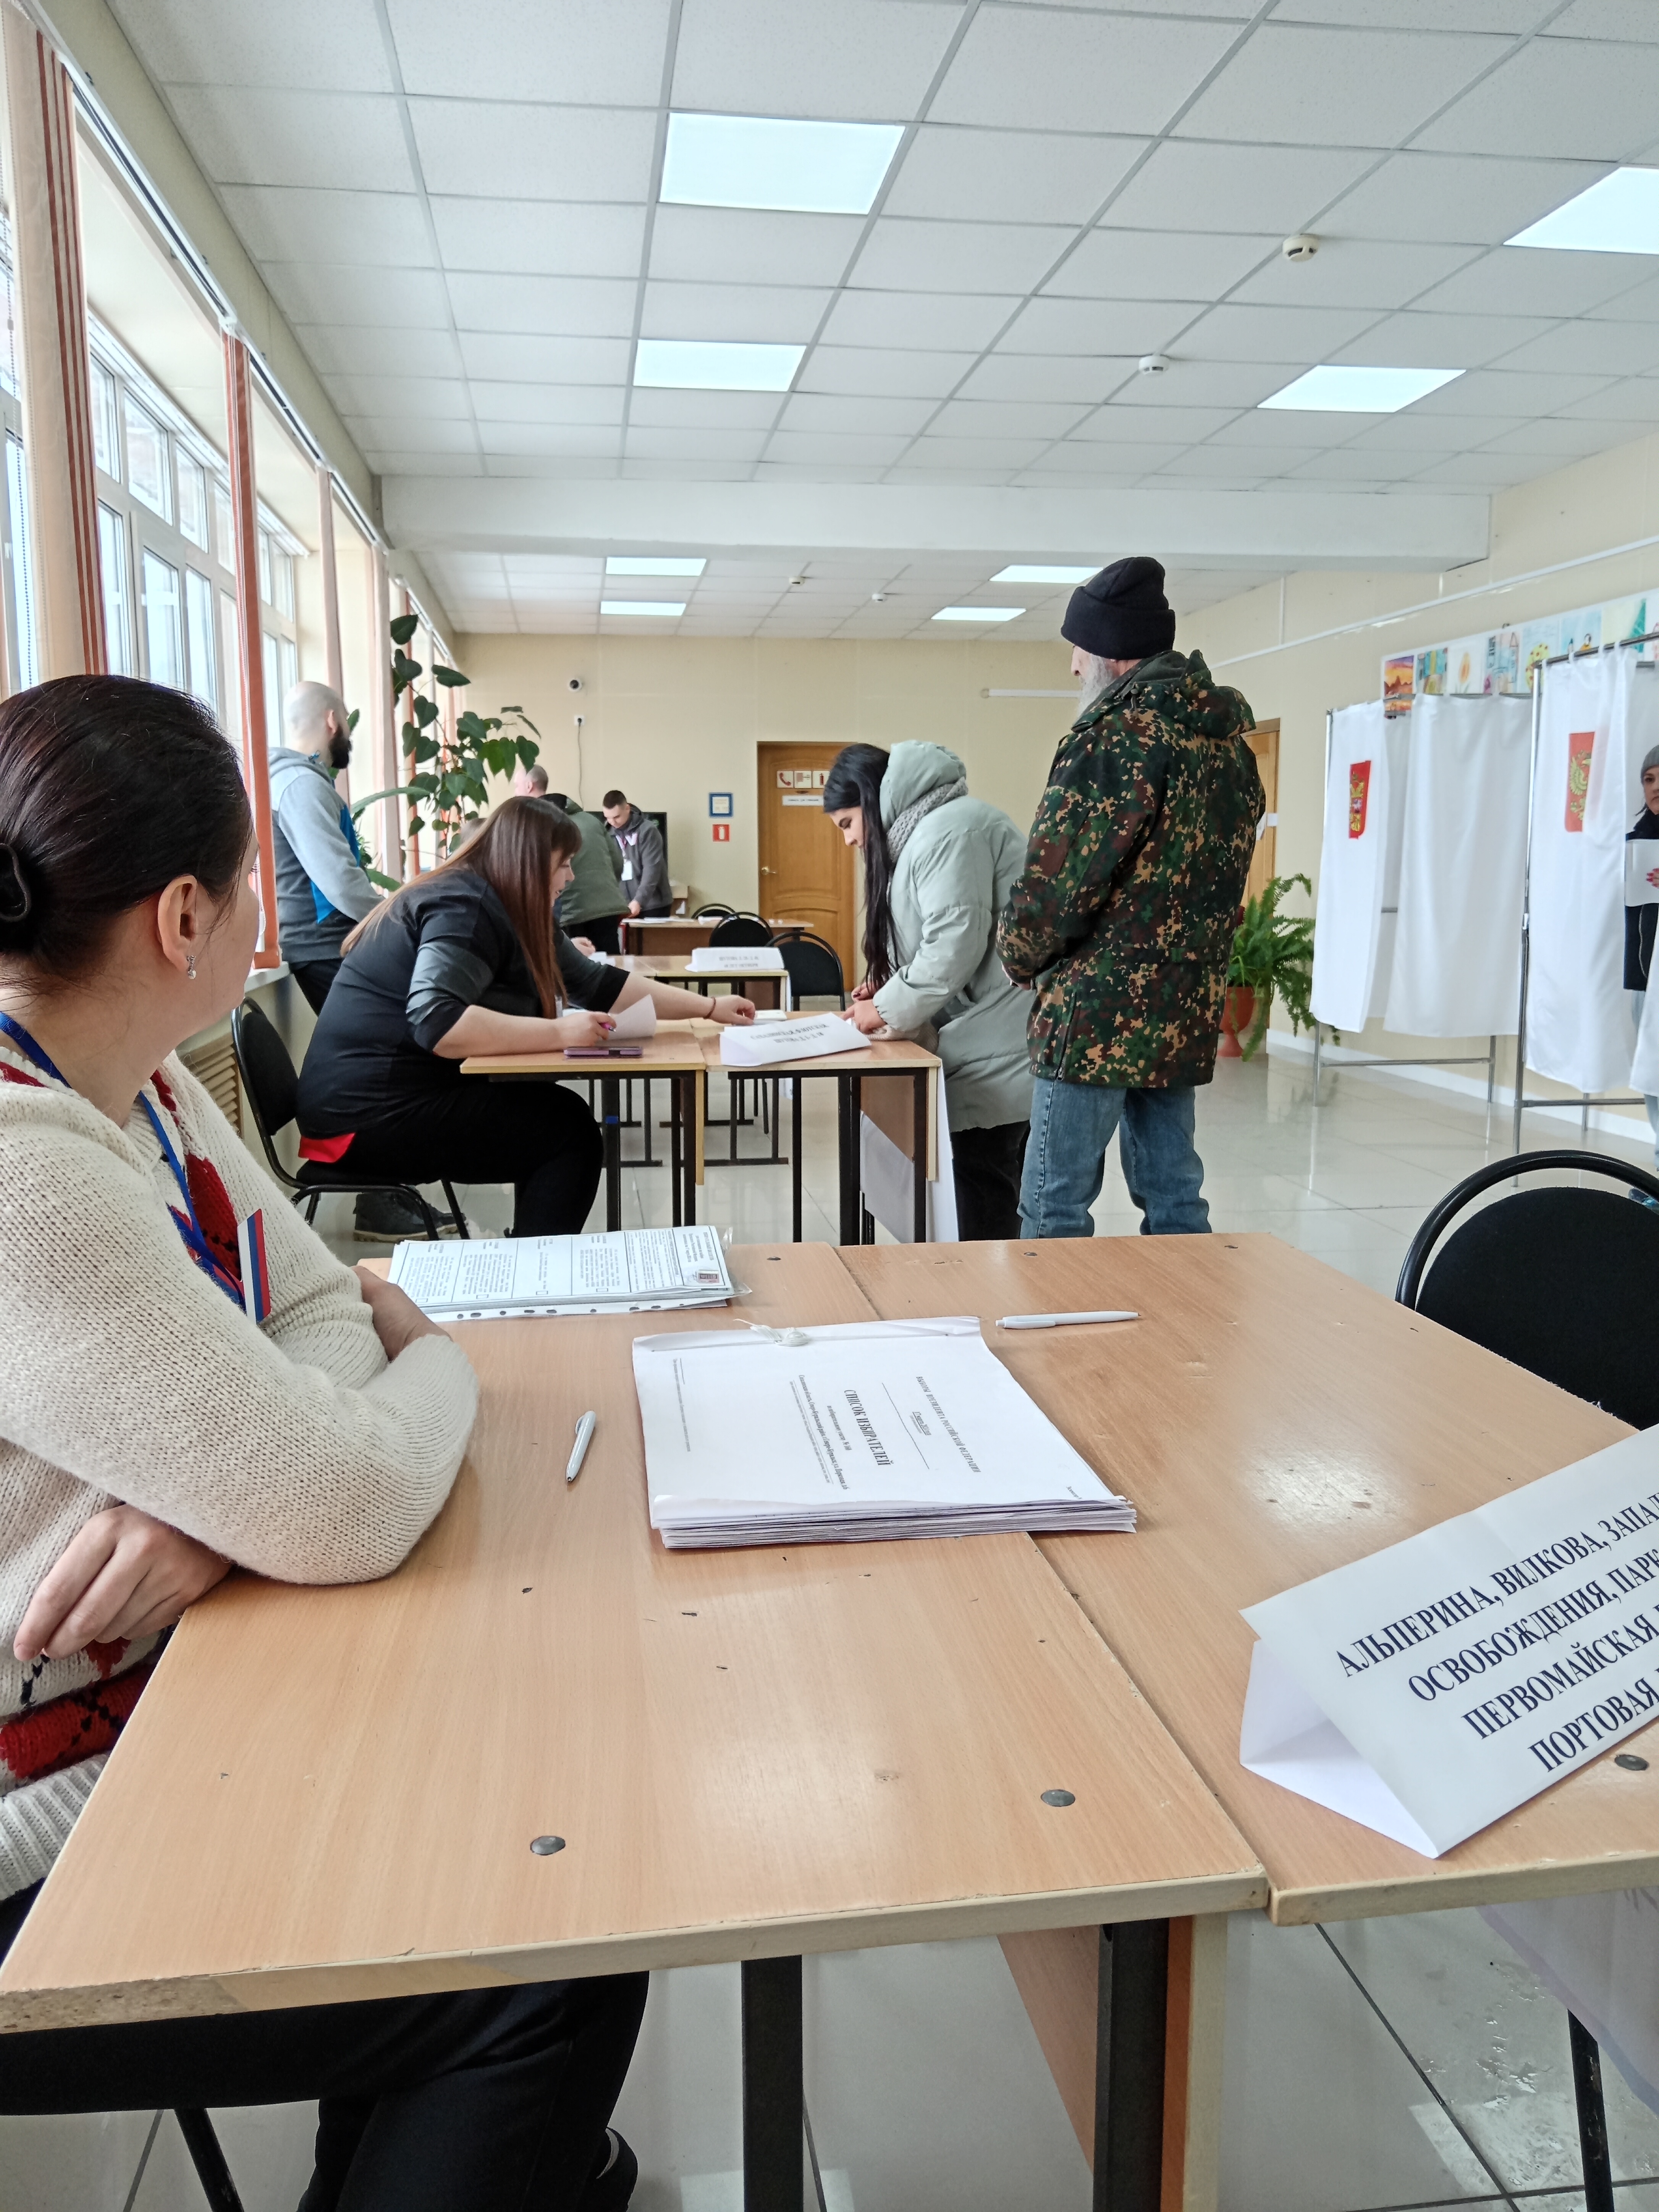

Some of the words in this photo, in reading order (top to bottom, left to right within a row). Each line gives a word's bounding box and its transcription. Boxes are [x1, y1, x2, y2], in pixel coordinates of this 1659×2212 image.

[844, 1389, 866, 1416] СПИСОК
[856, 1417, 894, 1466] ИЗБИРАТЕЛЕЙ
[916, 1376, 931, 1392] ВЫБОРЫ
[926, 1394, 946, 1419] ПРЕЗИДЕНТА
[941, 1420, 965, 1446] РОССИЙСКОЙ
[959, 1447, 981, 1472] ФЕДЕРАЦИИ
[1336, 1585, 1504, 1678] АЛЬПЕРИНА,
[1489, 1531, 1612, 1596] ВИЛКОВА,
[1408, 1580, 1622, 1701] ОСВОБОЖДЕНИЯ,
[1460, 1614, 1659, 1740] ПЕРВОМАЙСКАЯ
[1527, 1677, 1659, 1772] ПОРТОВАЯ
